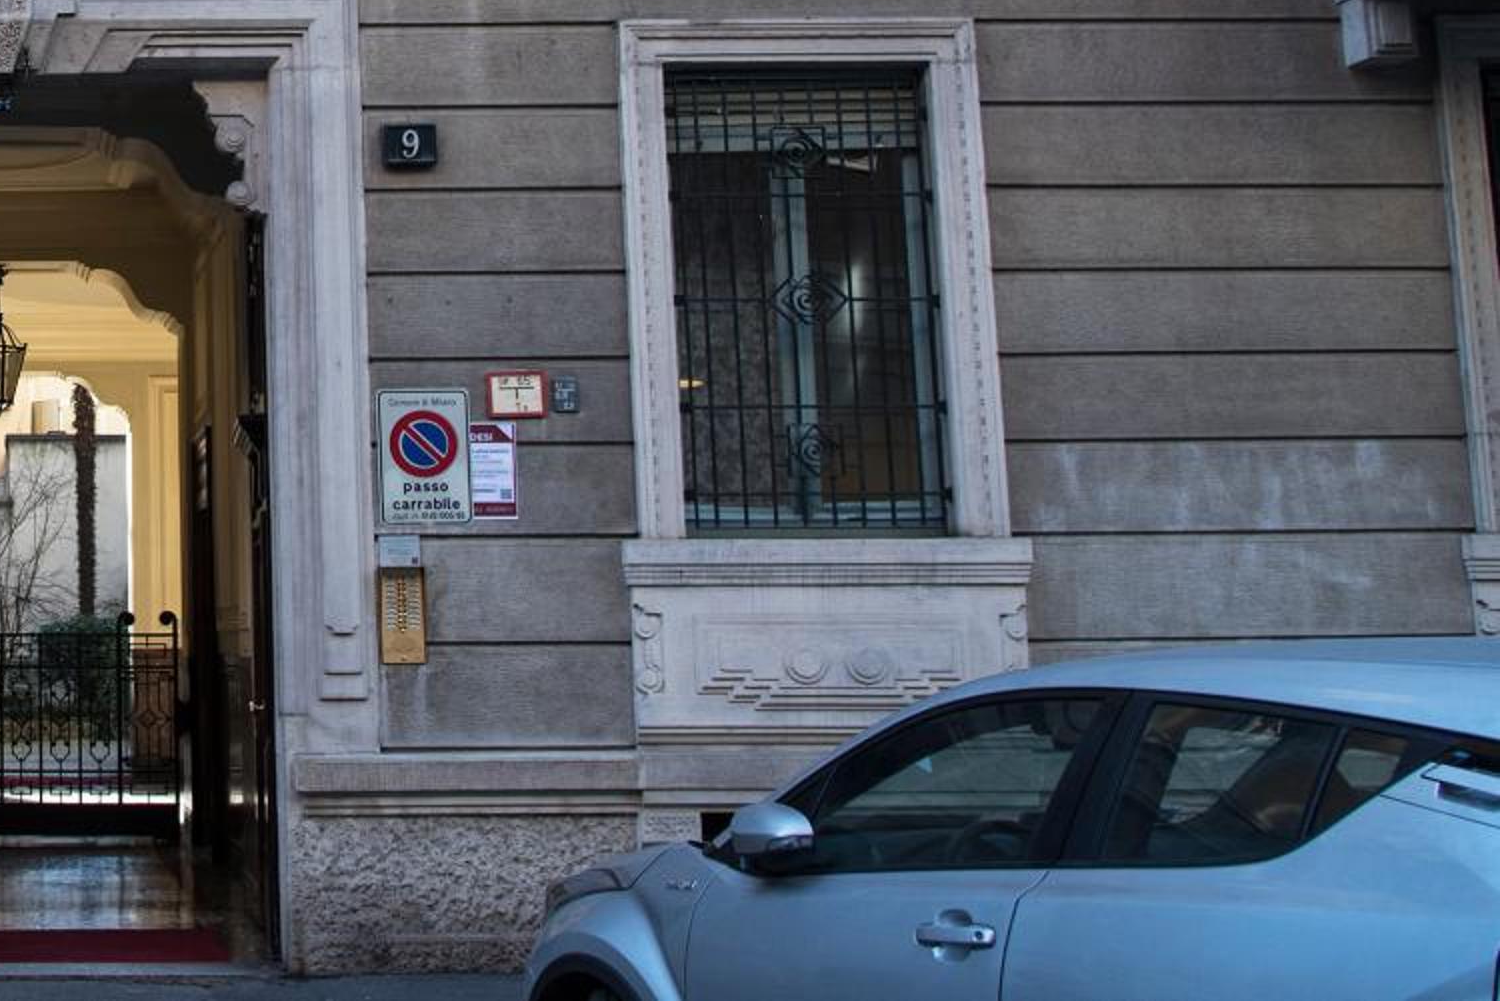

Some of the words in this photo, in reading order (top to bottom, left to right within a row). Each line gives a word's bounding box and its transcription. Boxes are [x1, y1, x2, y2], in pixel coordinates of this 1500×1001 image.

[401, 129, 420, 158] 9
[403, 482, 449, 495] passo
[393, 498, 461, 510] carrabile
